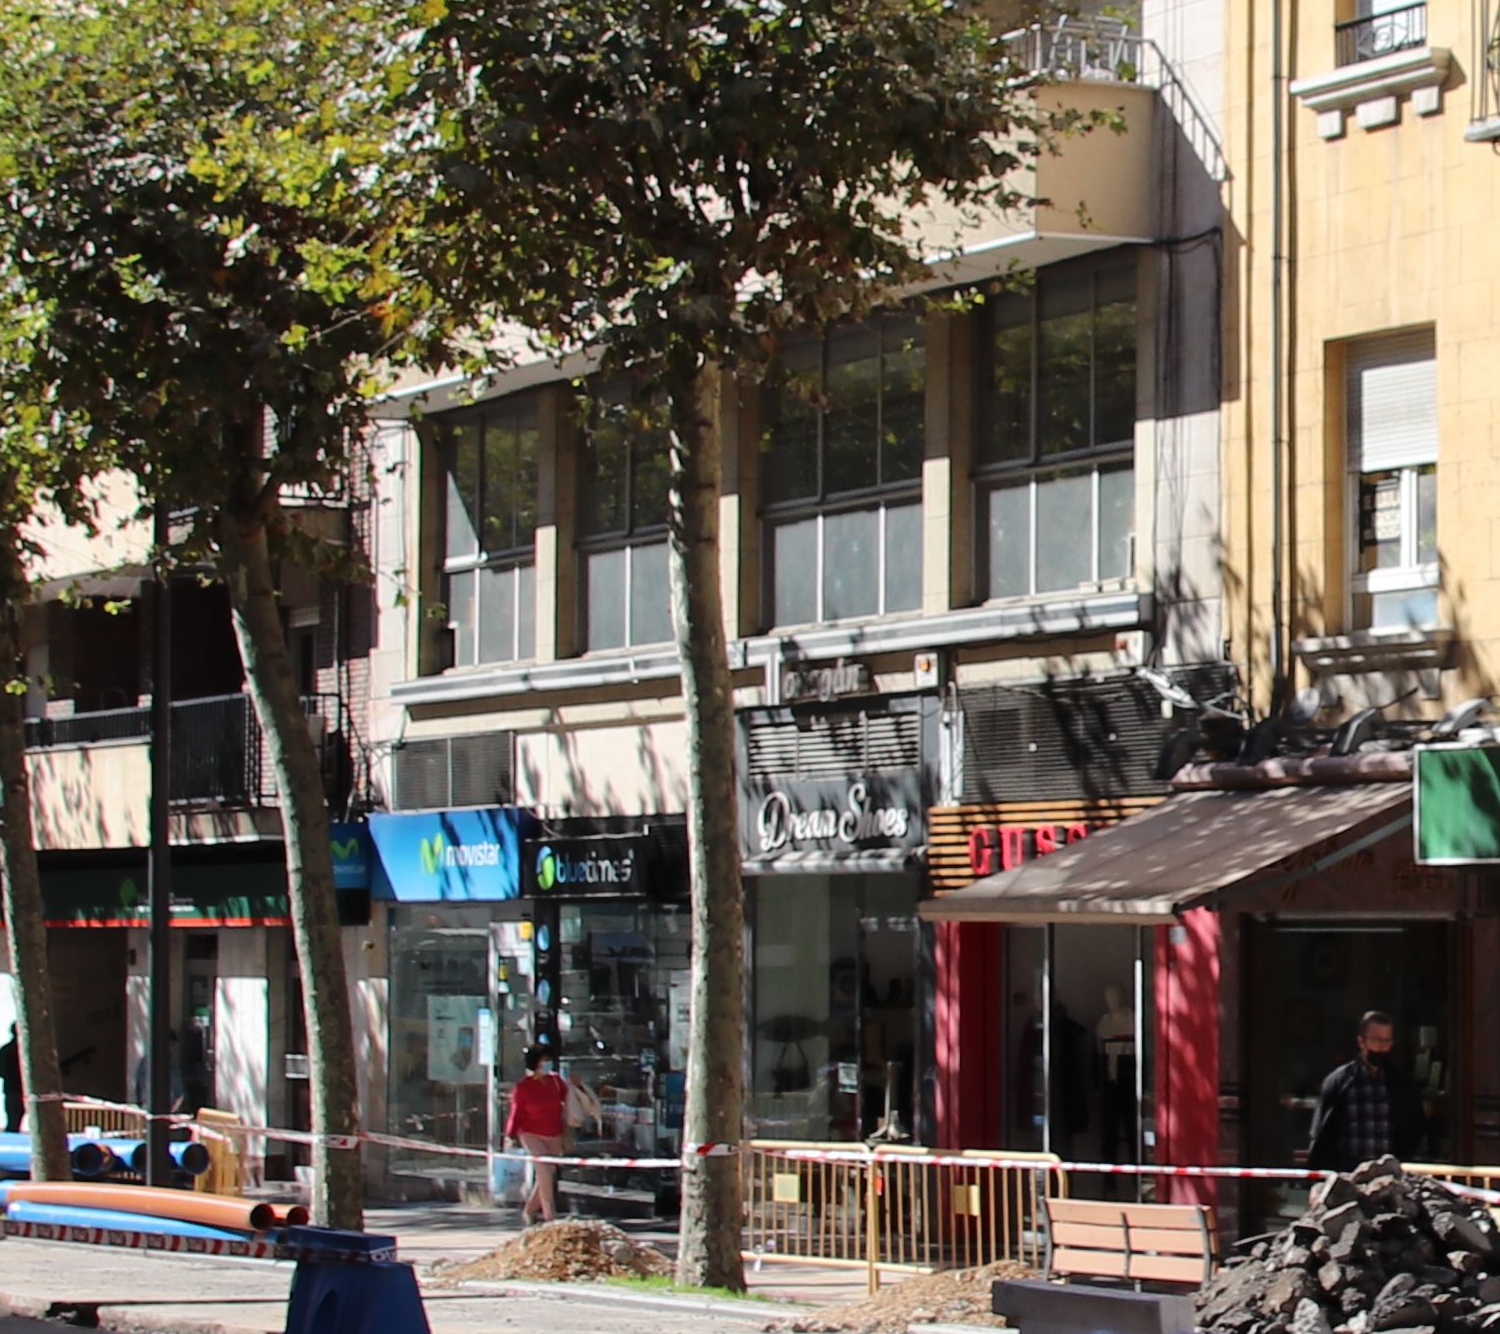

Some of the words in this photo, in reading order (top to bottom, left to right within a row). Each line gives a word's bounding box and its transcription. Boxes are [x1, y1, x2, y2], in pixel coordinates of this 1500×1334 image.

[757, 791, 838, 851] Dream
[838, 783, 909, 843] Shoes
[445, 840, 501, 867] movistar
